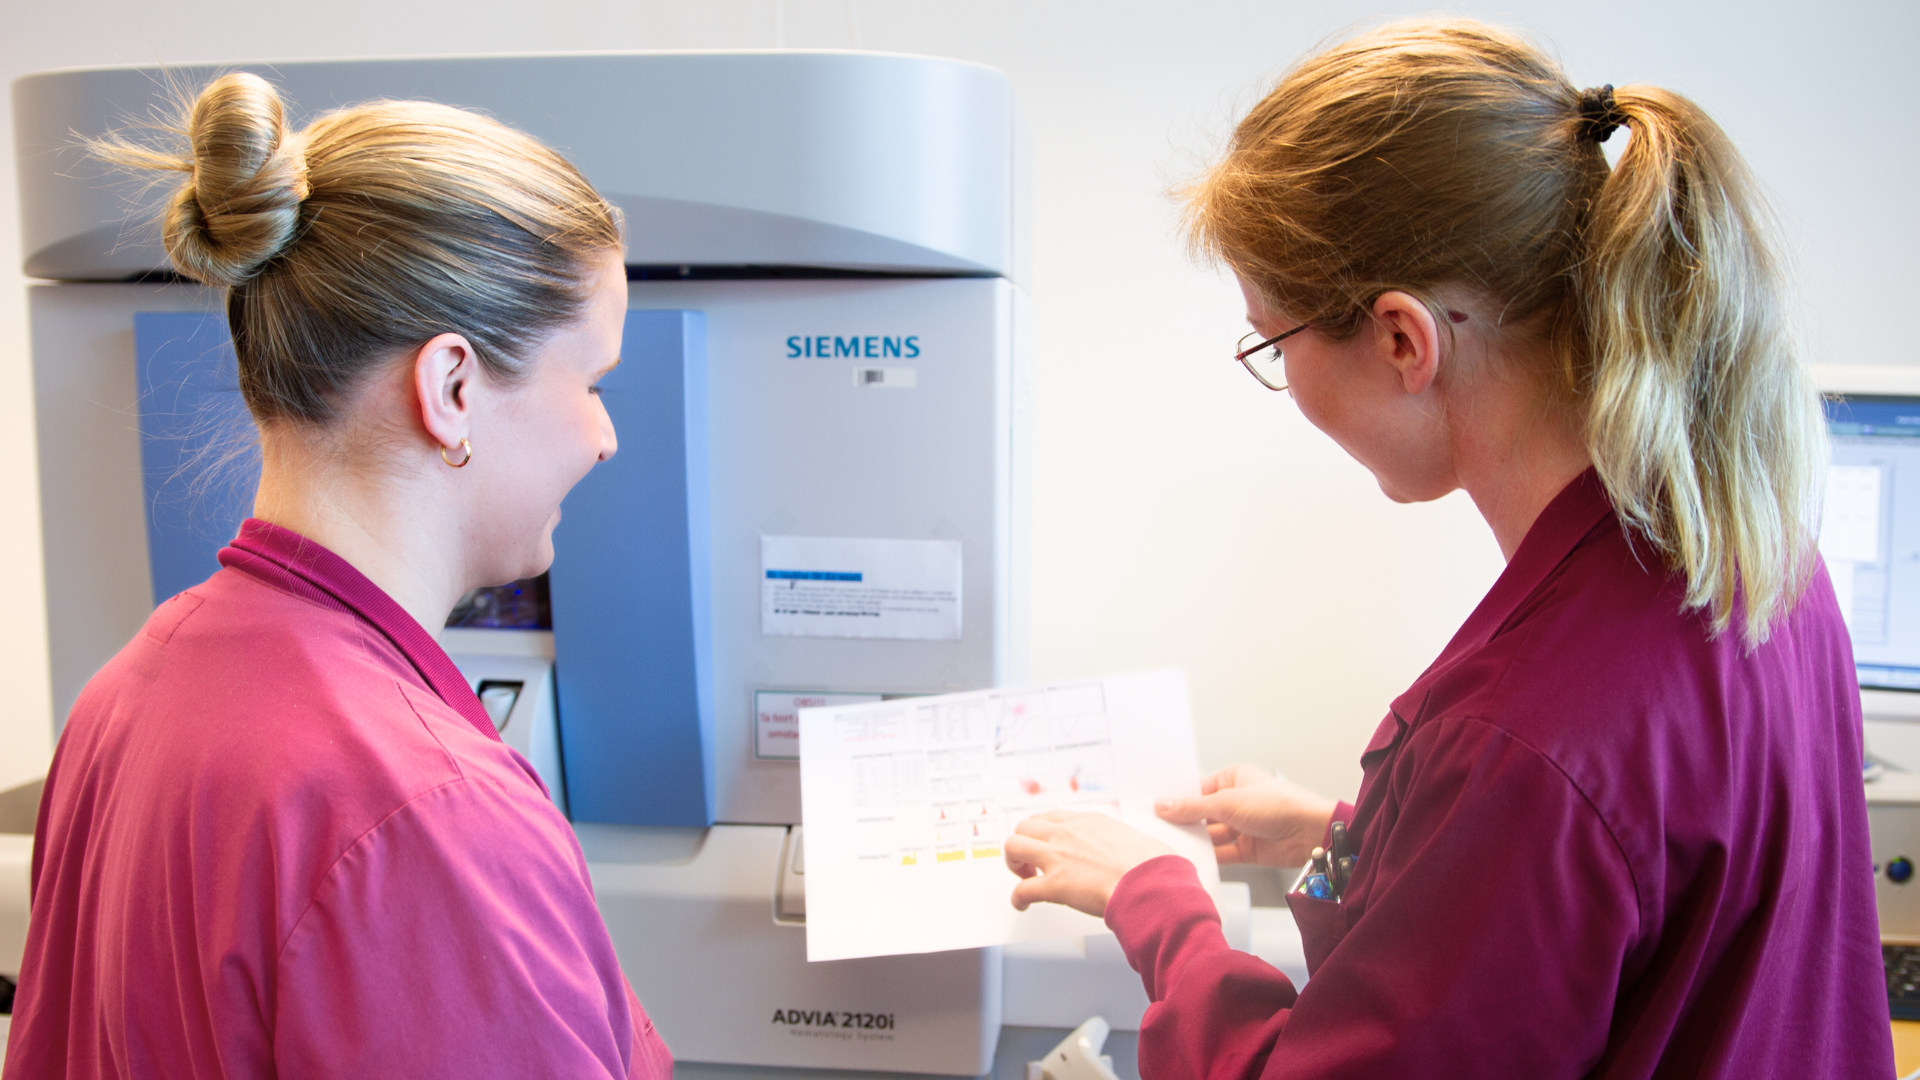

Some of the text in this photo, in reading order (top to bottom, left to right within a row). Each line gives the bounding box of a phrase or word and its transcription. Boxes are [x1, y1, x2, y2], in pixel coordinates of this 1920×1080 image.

[786, 335, 921, 359] SIEMENS
[767, 730, 799, 740] omsta
[772, 1008, 895, 1030] ADVIA 2120i
[789, 1028, 895, 1043] Hematology System
